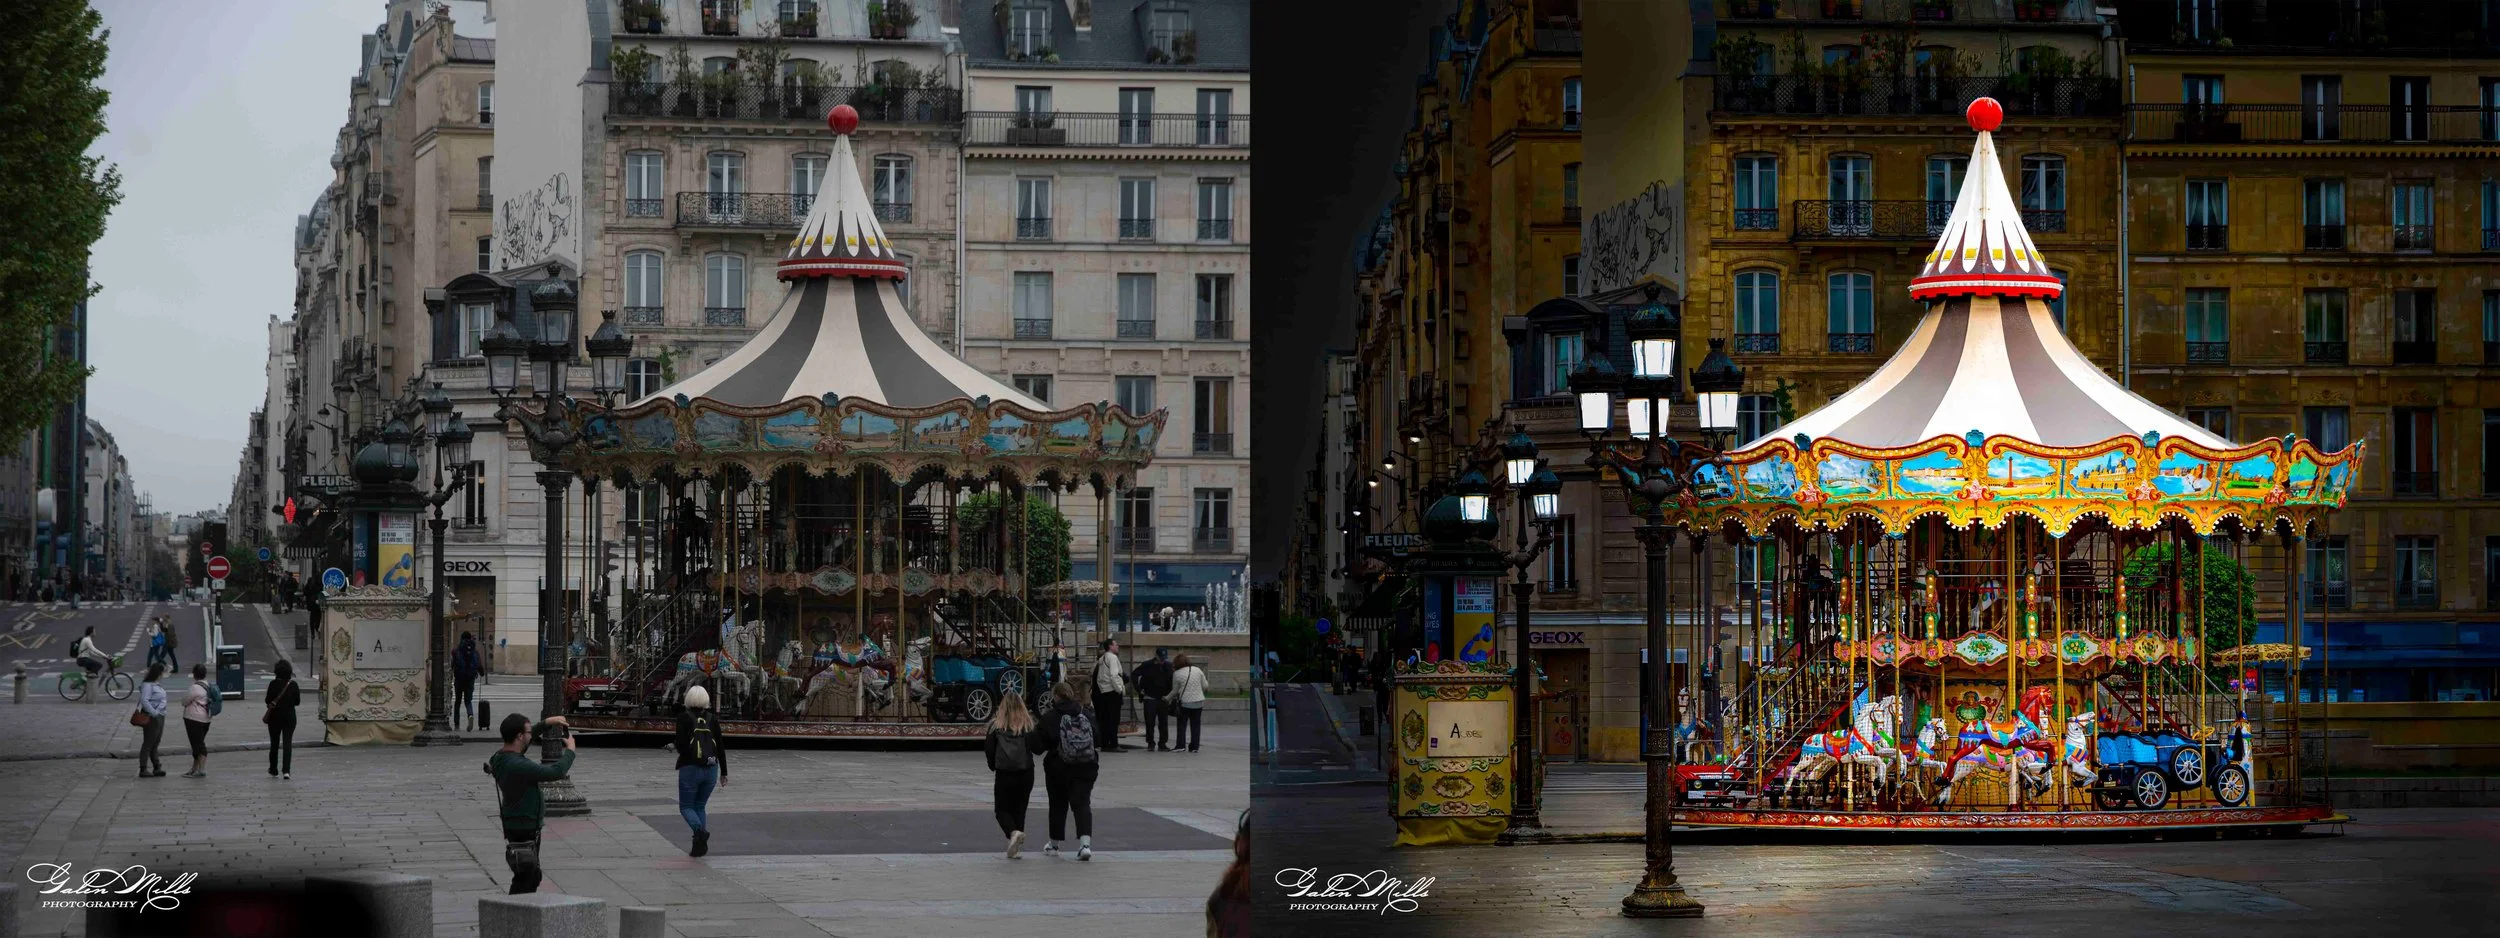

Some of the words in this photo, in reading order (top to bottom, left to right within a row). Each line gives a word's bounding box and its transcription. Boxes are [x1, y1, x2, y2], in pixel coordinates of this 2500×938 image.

[302, 475, 352, 486] FLEURS
[1365, 534, 1423, 547] FLEURS
[443, 561, 492, 572] GEOX
[1528, 631, 1584, 644] GEOX
